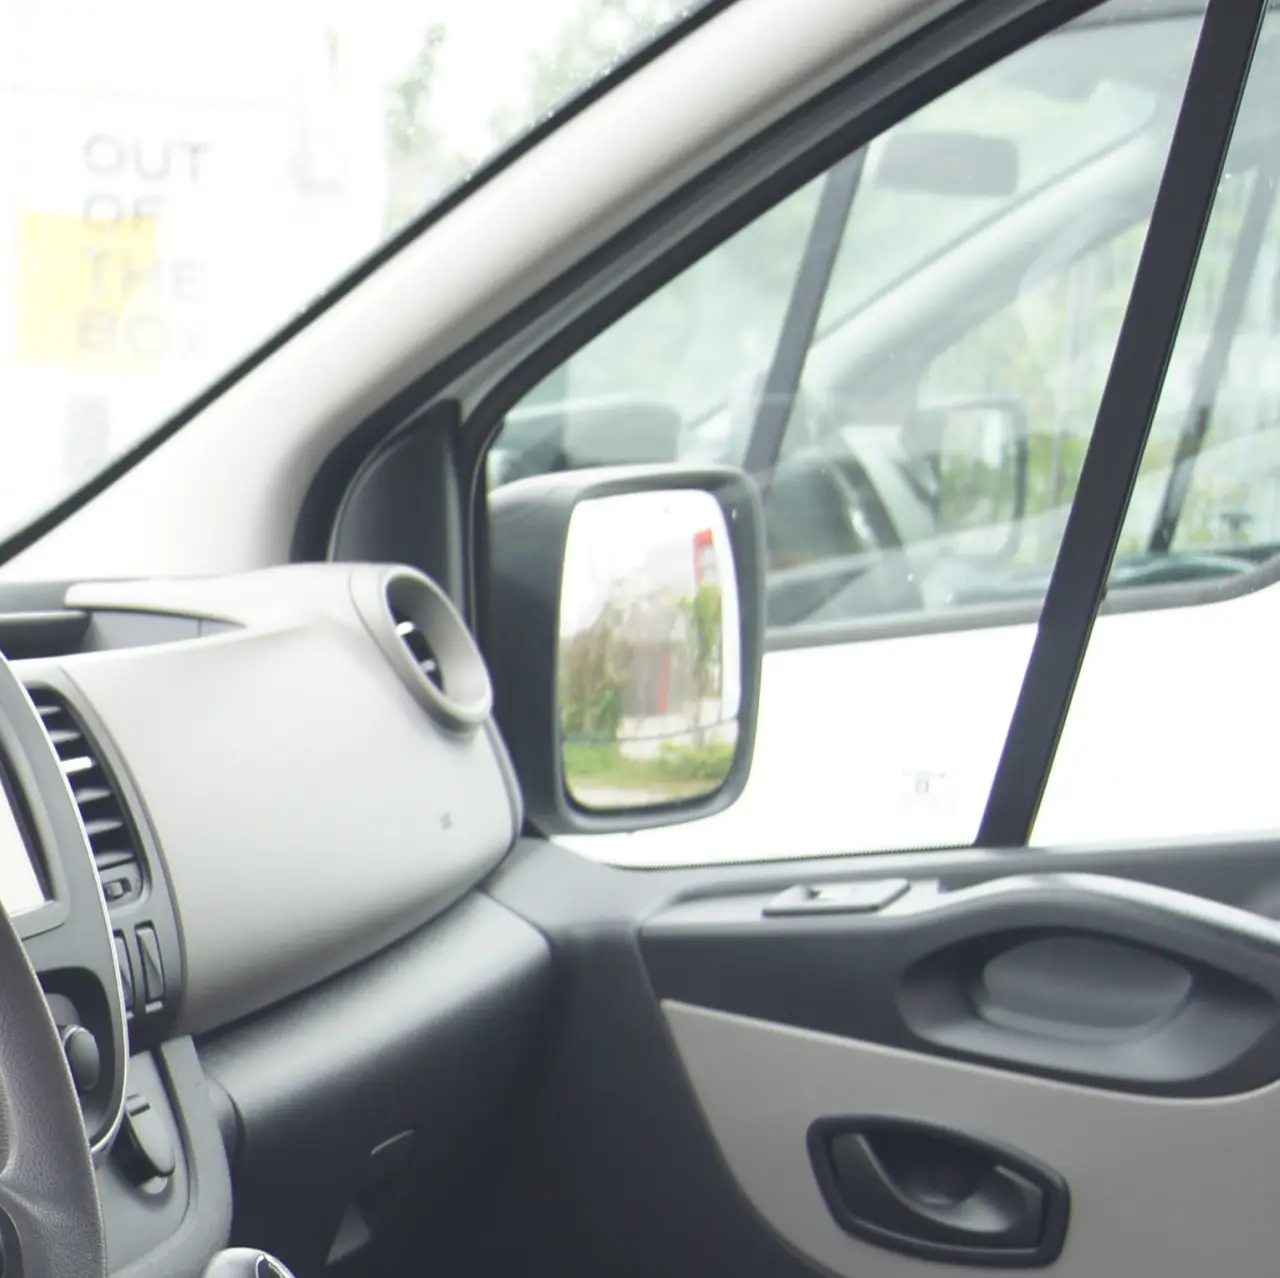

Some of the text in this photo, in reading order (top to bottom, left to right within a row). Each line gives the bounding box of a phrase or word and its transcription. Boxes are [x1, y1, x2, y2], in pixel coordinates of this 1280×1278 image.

[81, 131, 212, 183] OUT
[81, 191, 170, 236] OF
[79, 247, 208, 301] THE
